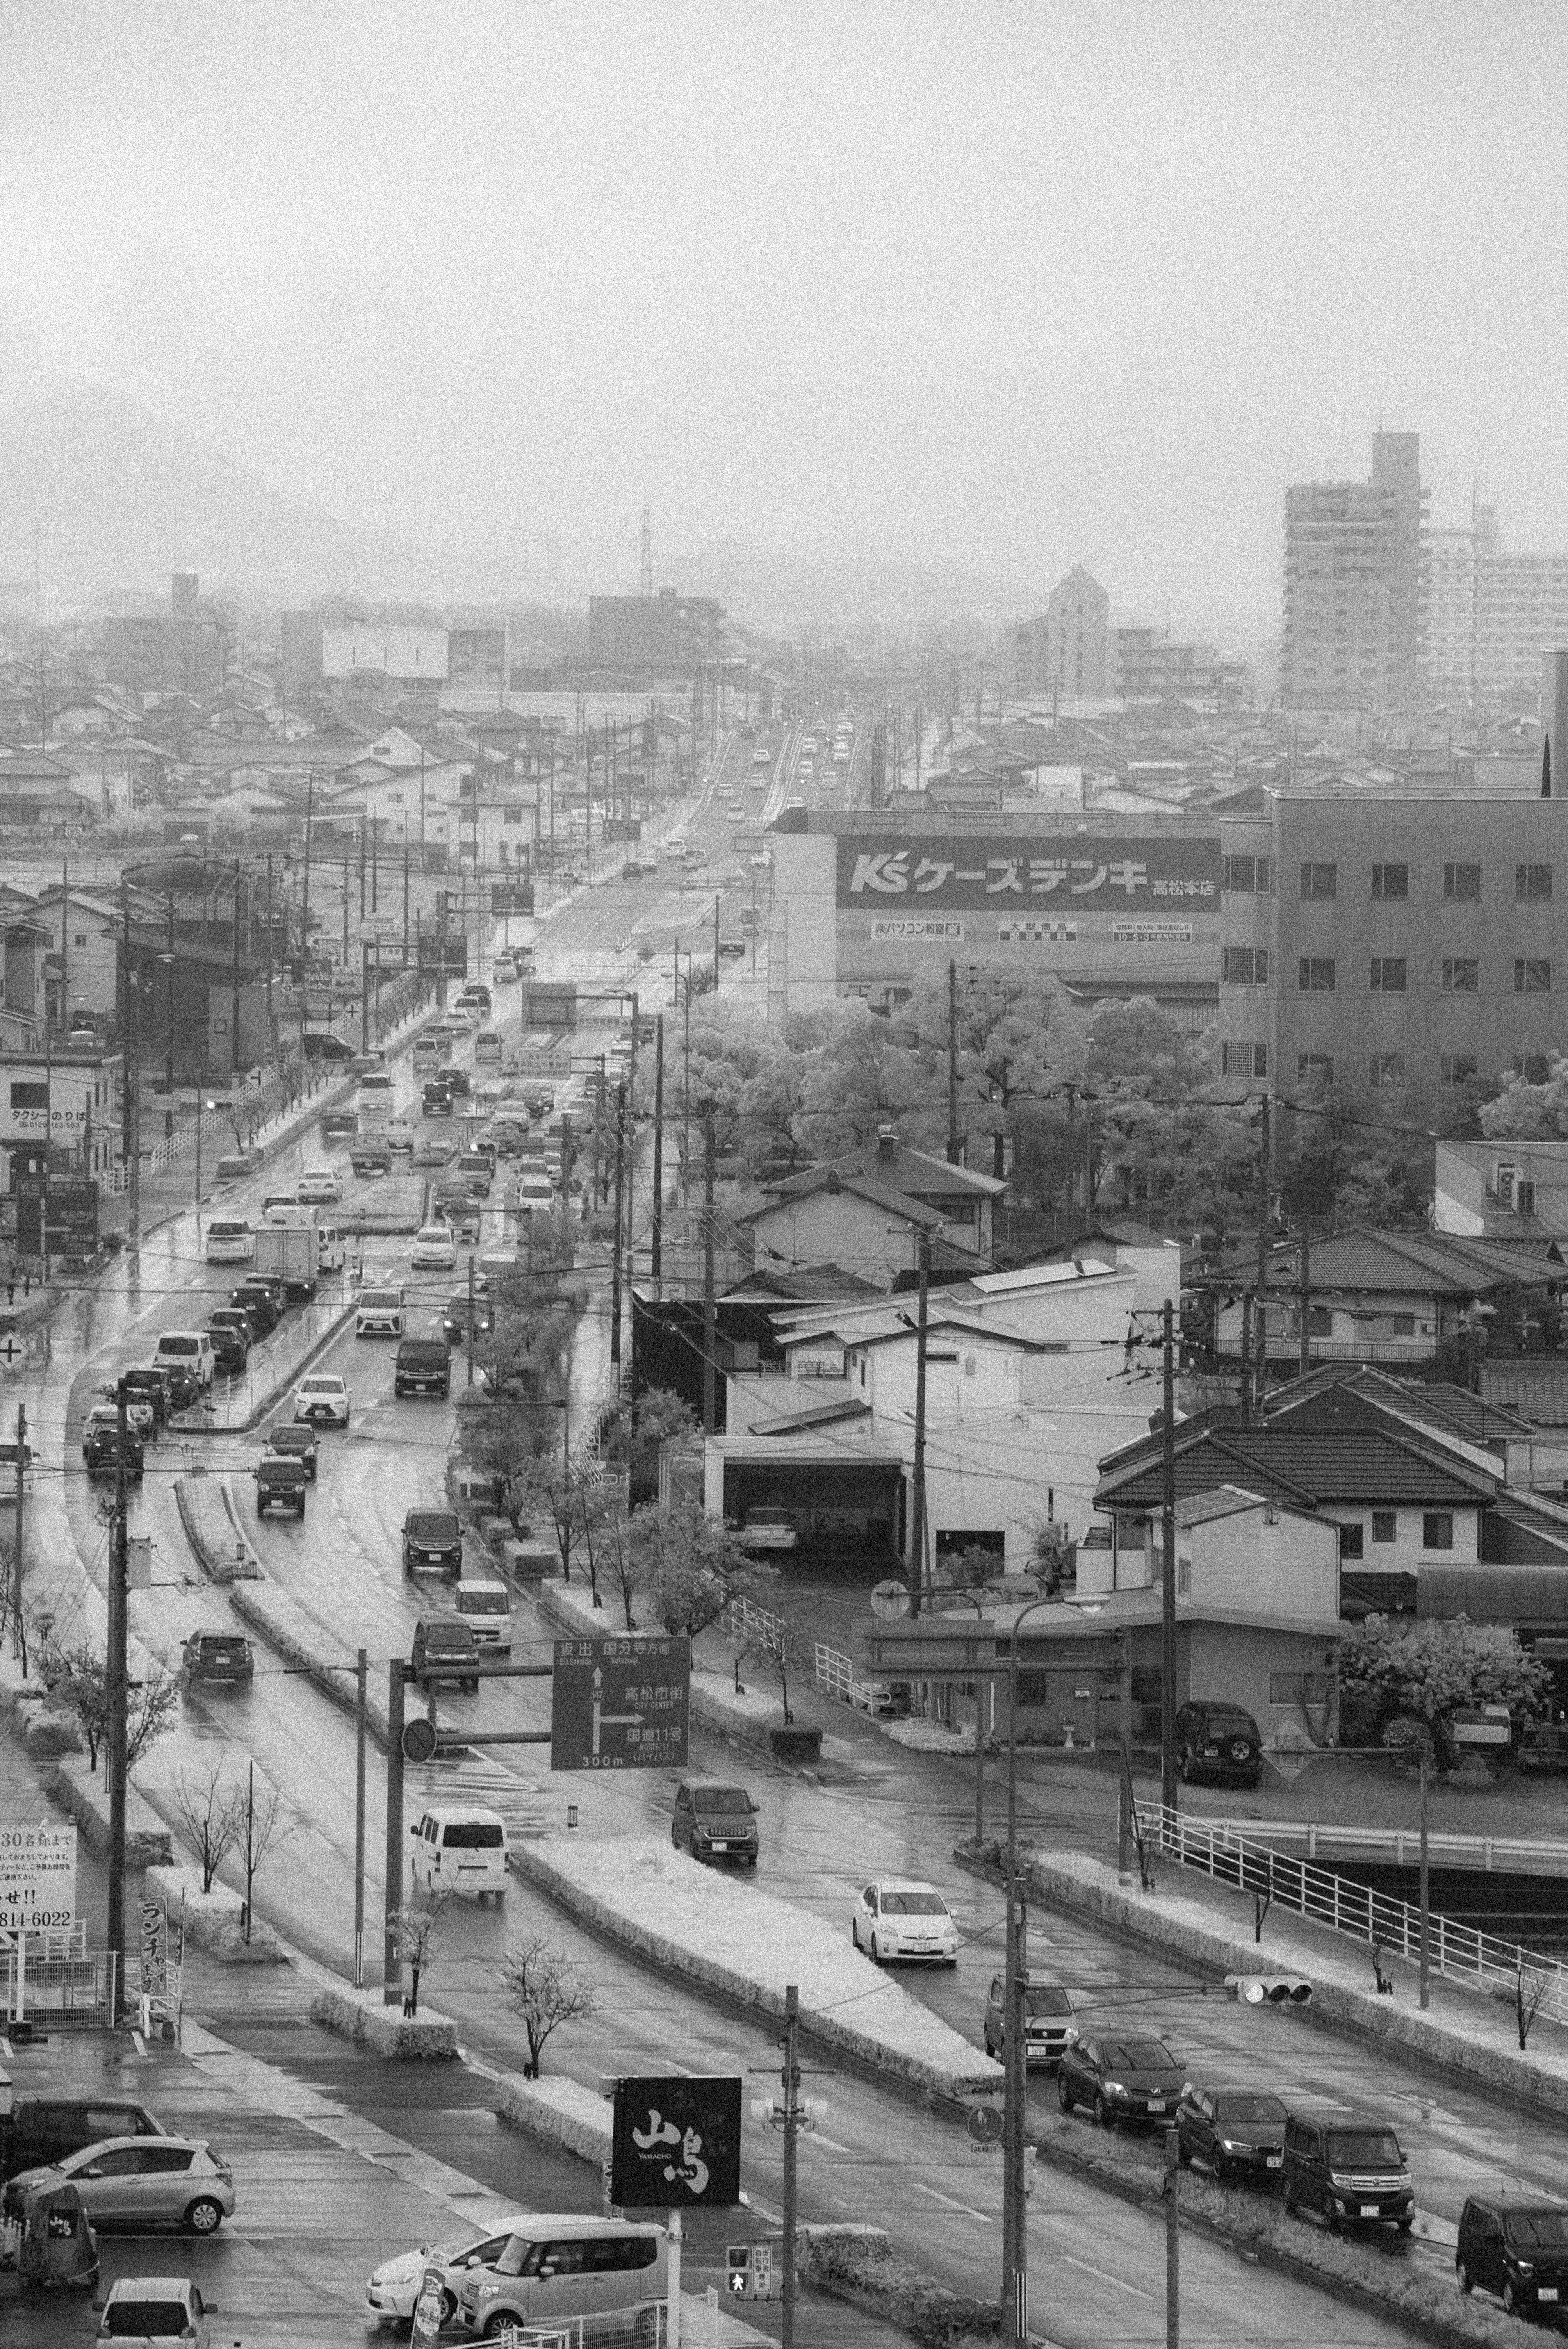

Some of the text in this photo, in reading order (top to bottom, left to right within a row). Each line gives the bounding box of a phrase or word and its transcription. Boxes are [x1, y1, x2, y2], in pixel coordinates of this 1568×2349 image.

[849, 851, 1215, 897] K's ケーズデンキ 高松本店
[875, 923, 945, 934] 楽パソコン教室
[1010, 922, 1067, 932] 大型商品
[1010, 932, 1067, 941] 配送無料
[20, 1183, 39, 1191] 坂出
[60, 1210, 94, 1219] 高松市街
[560, 1641, 670, 1657] 坂出 国分寺方面
[611, 1656, 638, 1665] Kokubunji
[592, 1690, 603, 1699] 147
[625, 1686, 683, 1701] 高松市街
[627, 1727, 682, 1743] 国道11号
[582, 1756, 624, 1767] 300m
[0, 1889, 36, 1904] せ!!
[0, 1911, 71, 1927] 814-6022
[141, 1902, 163, 1959] ランチ
[759, 2274, 765, 2289] 専用
